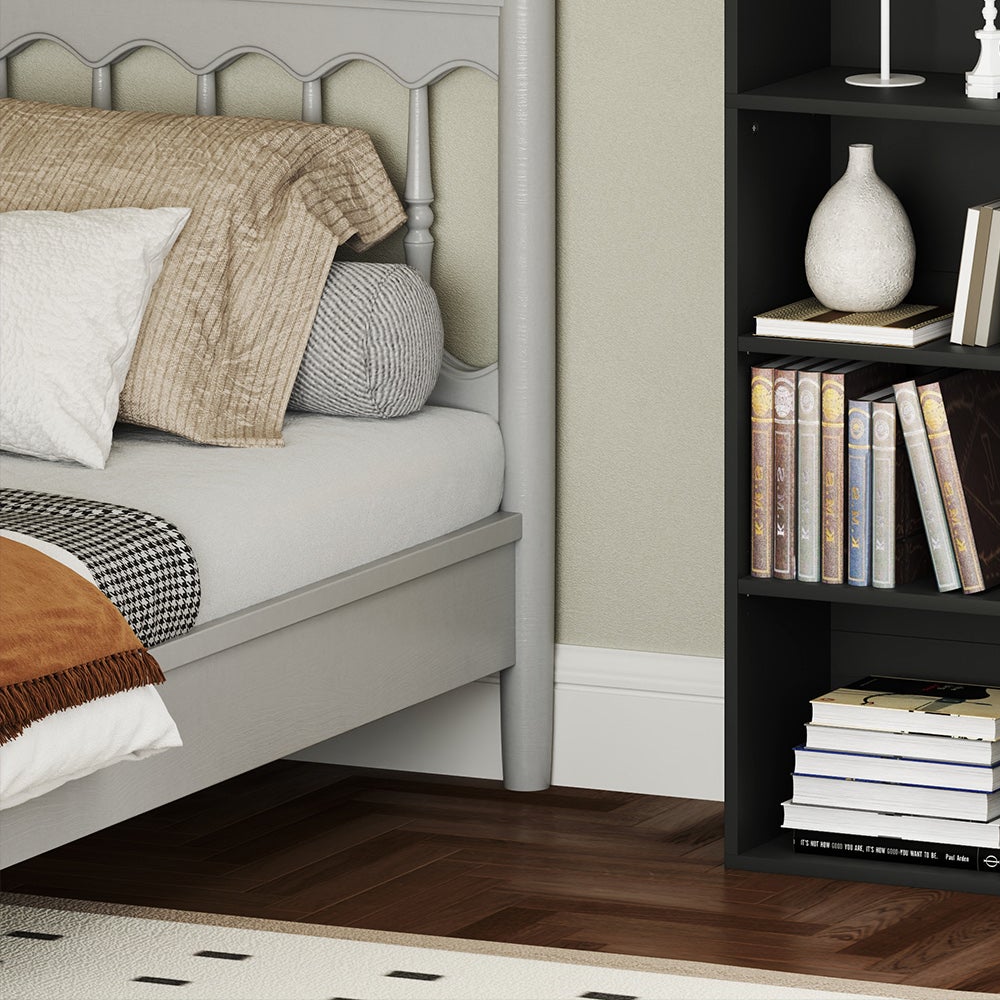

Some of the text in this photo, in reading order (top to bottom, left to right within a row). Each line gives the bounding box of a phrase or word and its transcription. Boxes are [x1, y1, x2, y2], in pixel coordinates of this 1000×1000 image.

[800, 839, 810, 847] IT'S
[810, 840, 819, 848] NOT
[820, 841, 831, 849] HOW
[831, 842, 843, 850] GOOD
[844, 843, 854, 851] YOU
[865, 845, 875, 853] IT'S
[875, 846, 886, 854] HOW
[910, 850, 923, 858] WANT
[924, 851, 930, 859] TO
[945, 853, 955, 861] Paul
[956, 854, 970, 863] Arden
